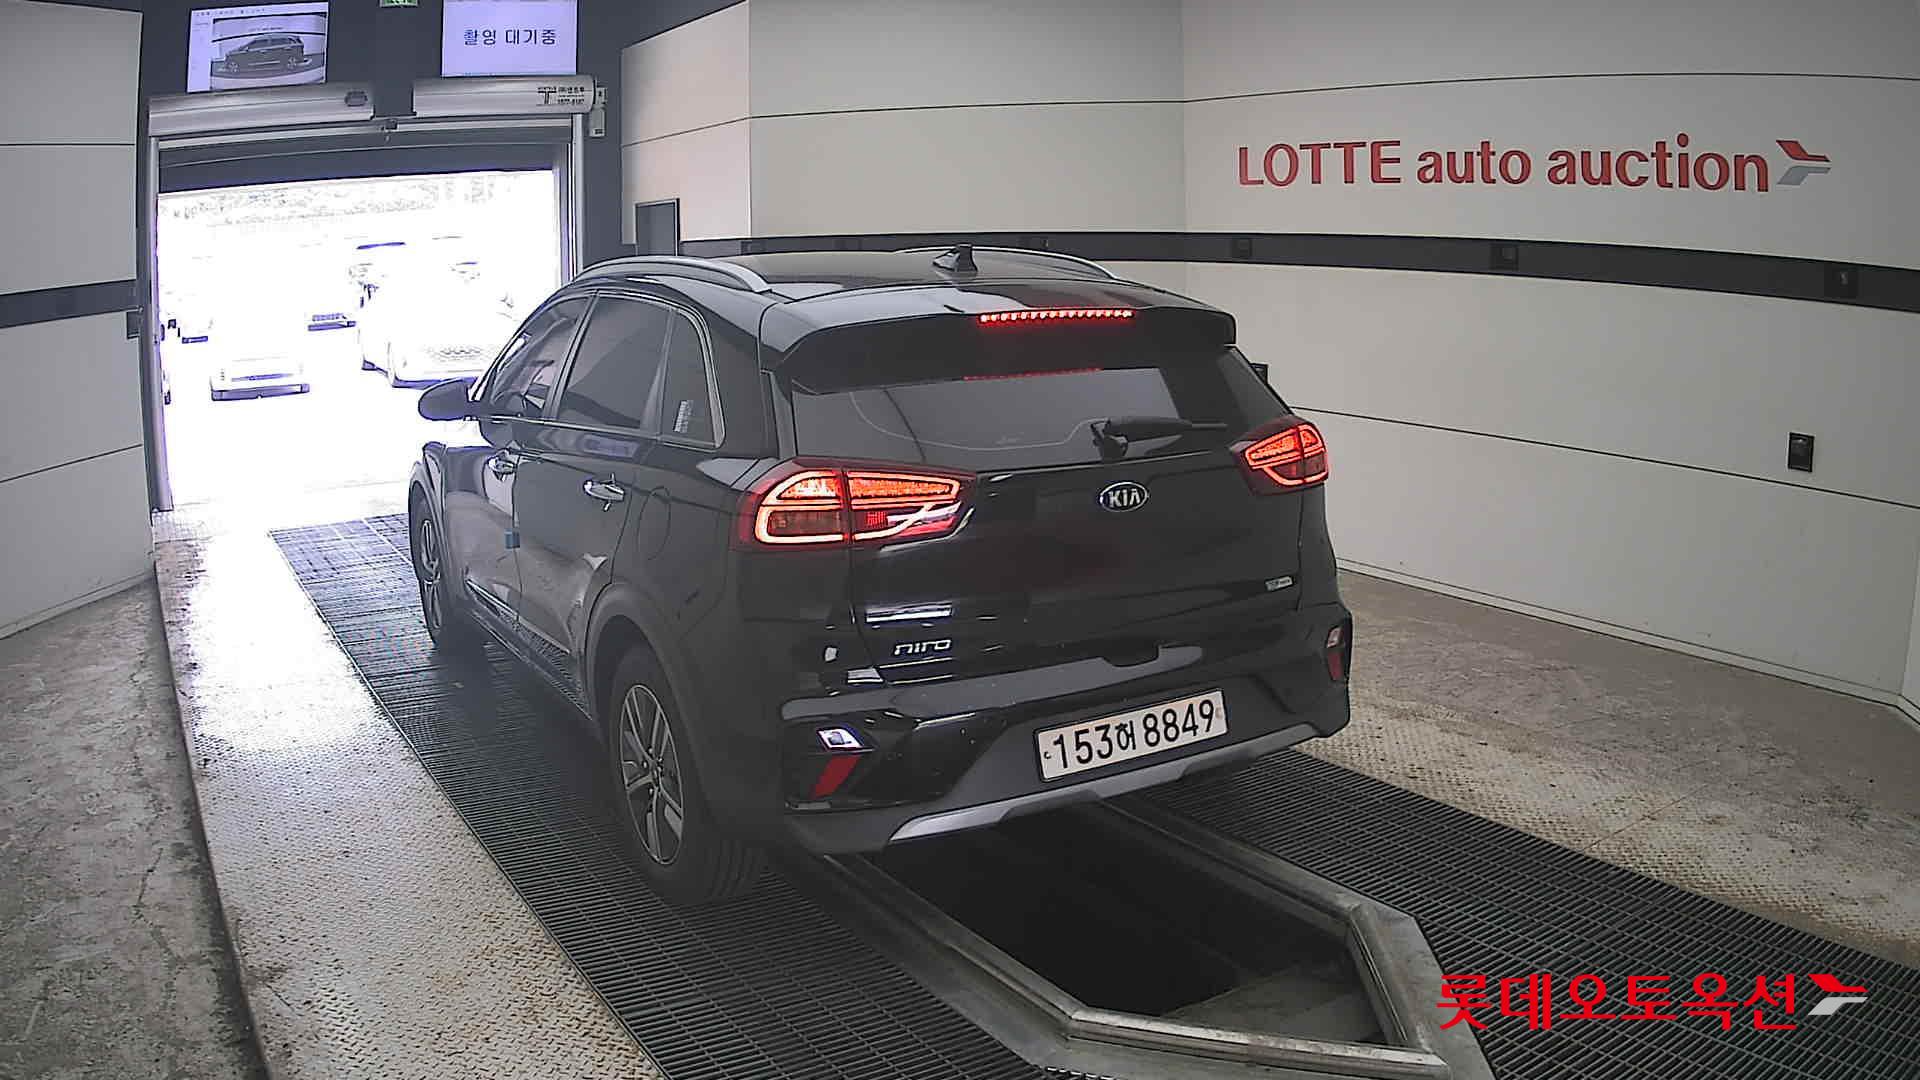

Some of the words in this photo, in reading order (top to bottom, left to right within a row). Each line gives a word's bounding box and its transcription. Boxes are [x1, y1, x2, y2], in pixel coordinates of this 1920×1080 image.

[505, 29, 556, 45] 대기중
[1239, 141, 1401, 186] LOTTE
[1416, 140, 1532, 185] auto
[1547, 133, 1769, 193] auction
[1108, 488, 1141, 508] KIA
